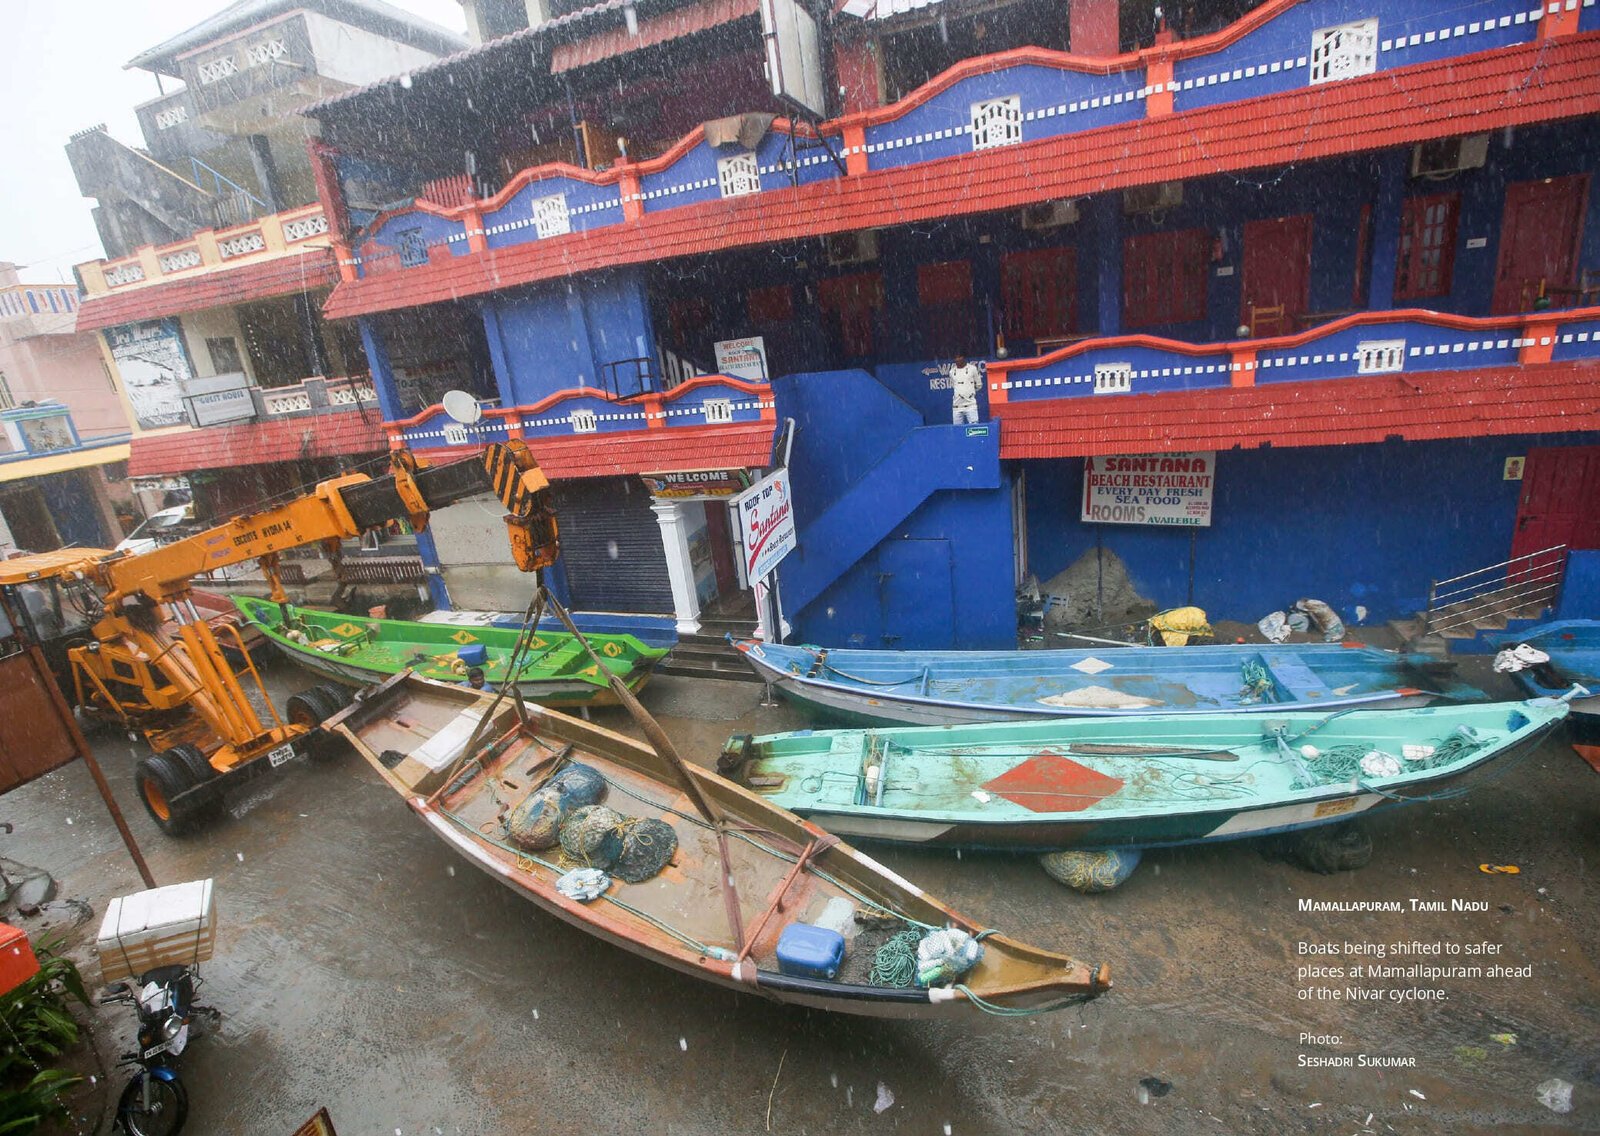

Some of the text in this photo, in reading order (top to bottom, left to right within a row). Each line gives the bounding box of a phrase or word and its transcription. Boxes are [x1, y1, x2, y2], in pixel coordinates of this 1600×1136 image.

[1105, 458, 1206, 472] SANTANA
[665, 471, 729, 483] WELCOME
[1091, 474, 1211, 488] BEACH RESTAURANT
[744, 485, 773, 512] ROOF TOP
[1097, 487, 1203, 497] EVERY DAY FRESH
[1115, 495, 1181, 505] SEA FOOD
[1091, 504, 1145, 521] ROOMS
[748, 499, 790, 551] Santana
[1147, 516, 1201, 525] AVAILEBLE
